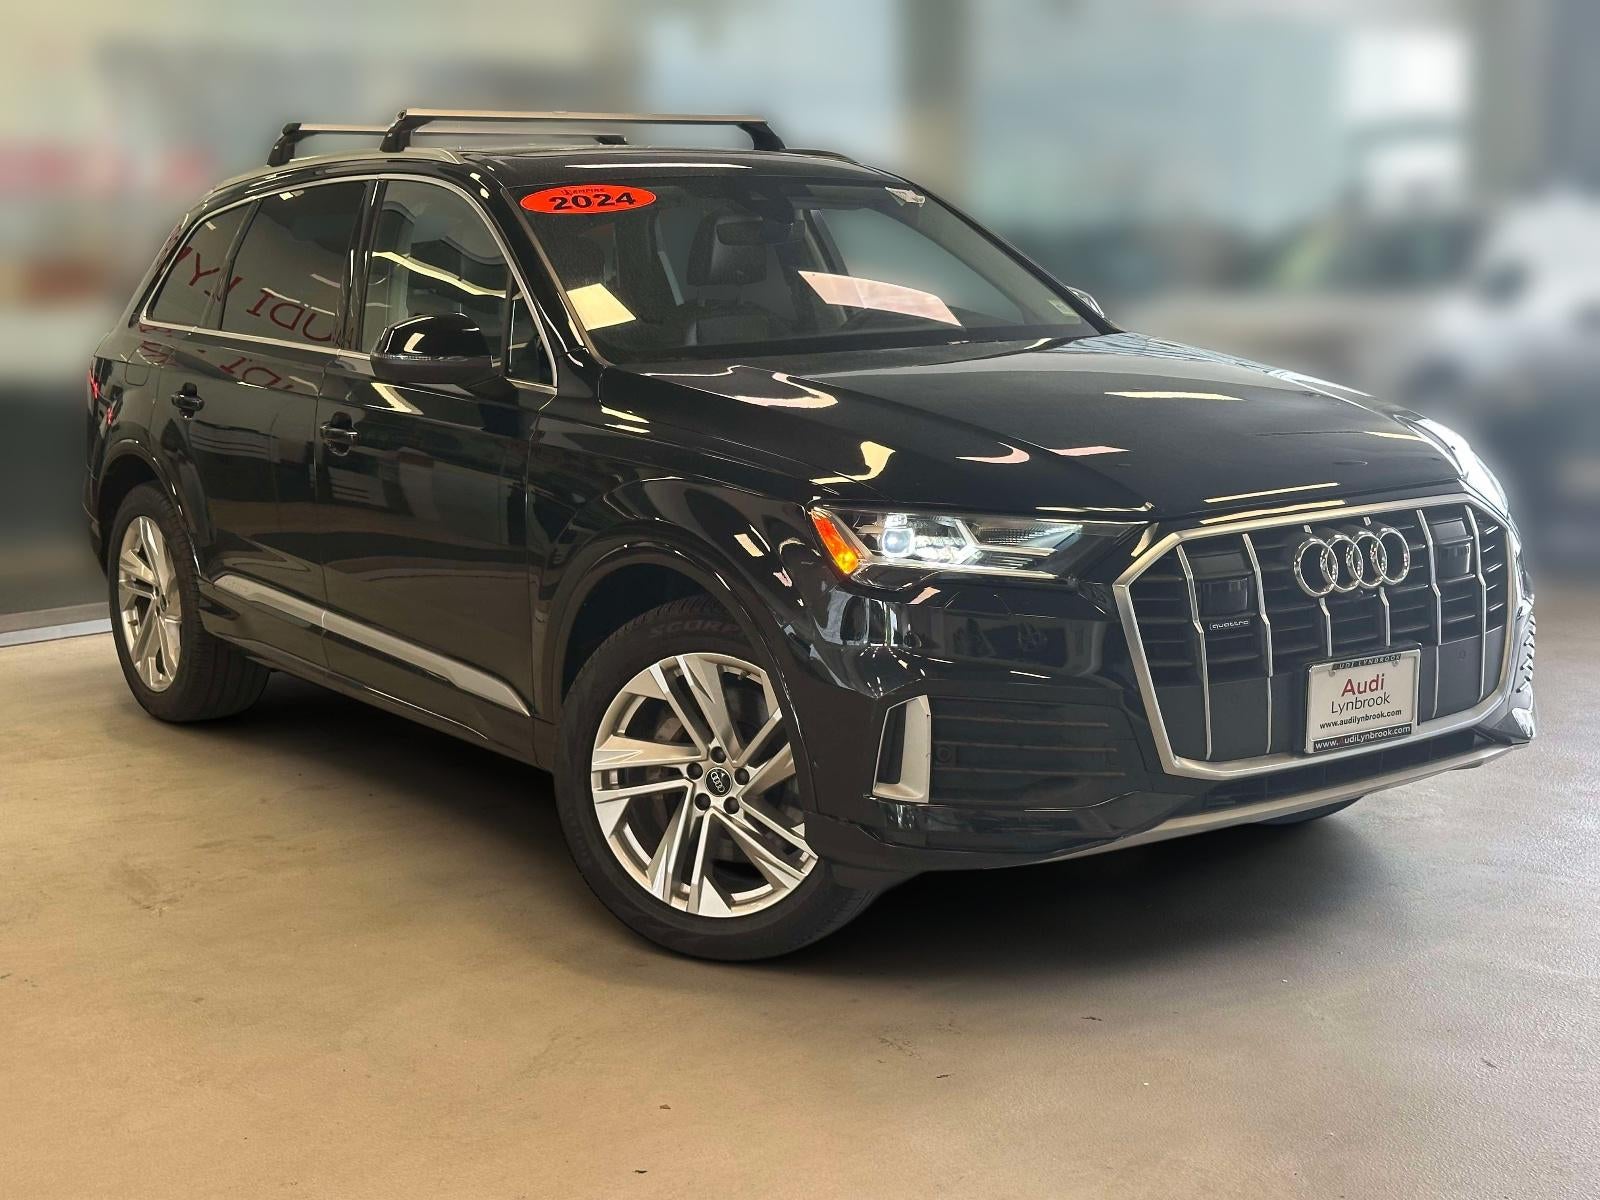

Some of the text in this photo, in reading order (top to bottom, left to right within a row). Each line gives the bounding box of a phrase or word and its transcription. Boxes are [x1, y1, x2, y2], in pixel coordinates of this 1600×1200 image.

[549, 192, 636, 210] 2024
[1212, 620, 1249, 629] quattro
[1341, 673, 1384, 696] Audi
[1331, 691, 1391, 715] Lynbrook
[1319, 709, 1402, 729] www.audilynbrook.com
